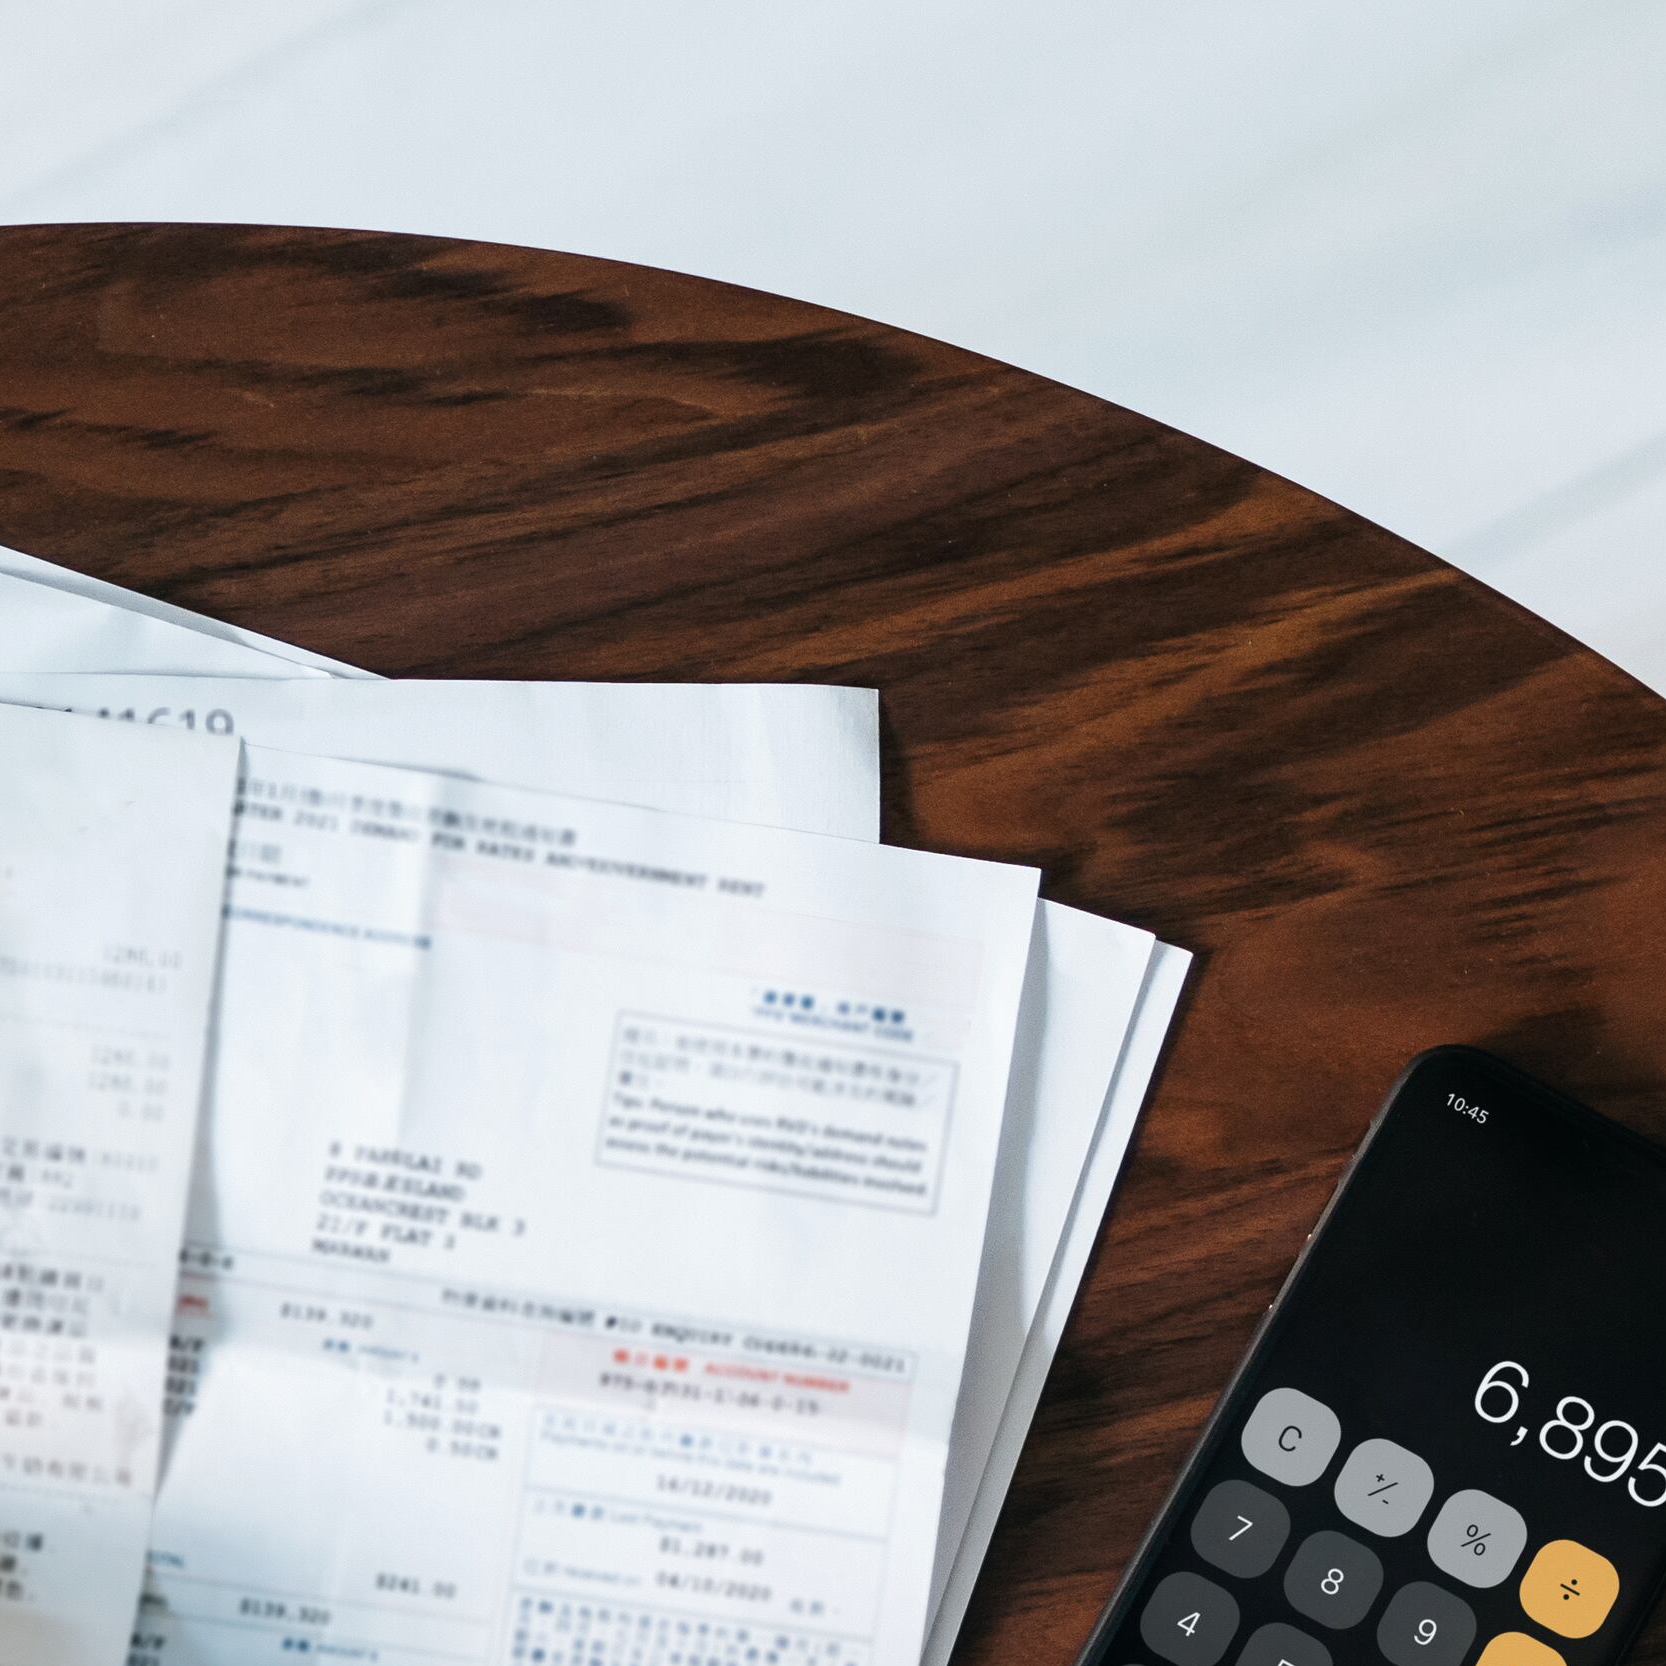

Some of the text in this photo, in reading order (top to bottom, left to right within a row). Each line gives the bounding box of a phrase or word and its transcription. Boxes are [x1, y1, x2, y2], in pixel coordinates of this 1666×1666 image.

[1445, 1091, 1490, 1126] 10:45
[1278, 1425, 1303, 1452] C
[1228, 1515, 1253, 1541] 7
[1320, 1568, 1345, 1595] 8
[1177, 1611, 1201, 1638] 4
[1413, 1618, 1437, 1646] 9
